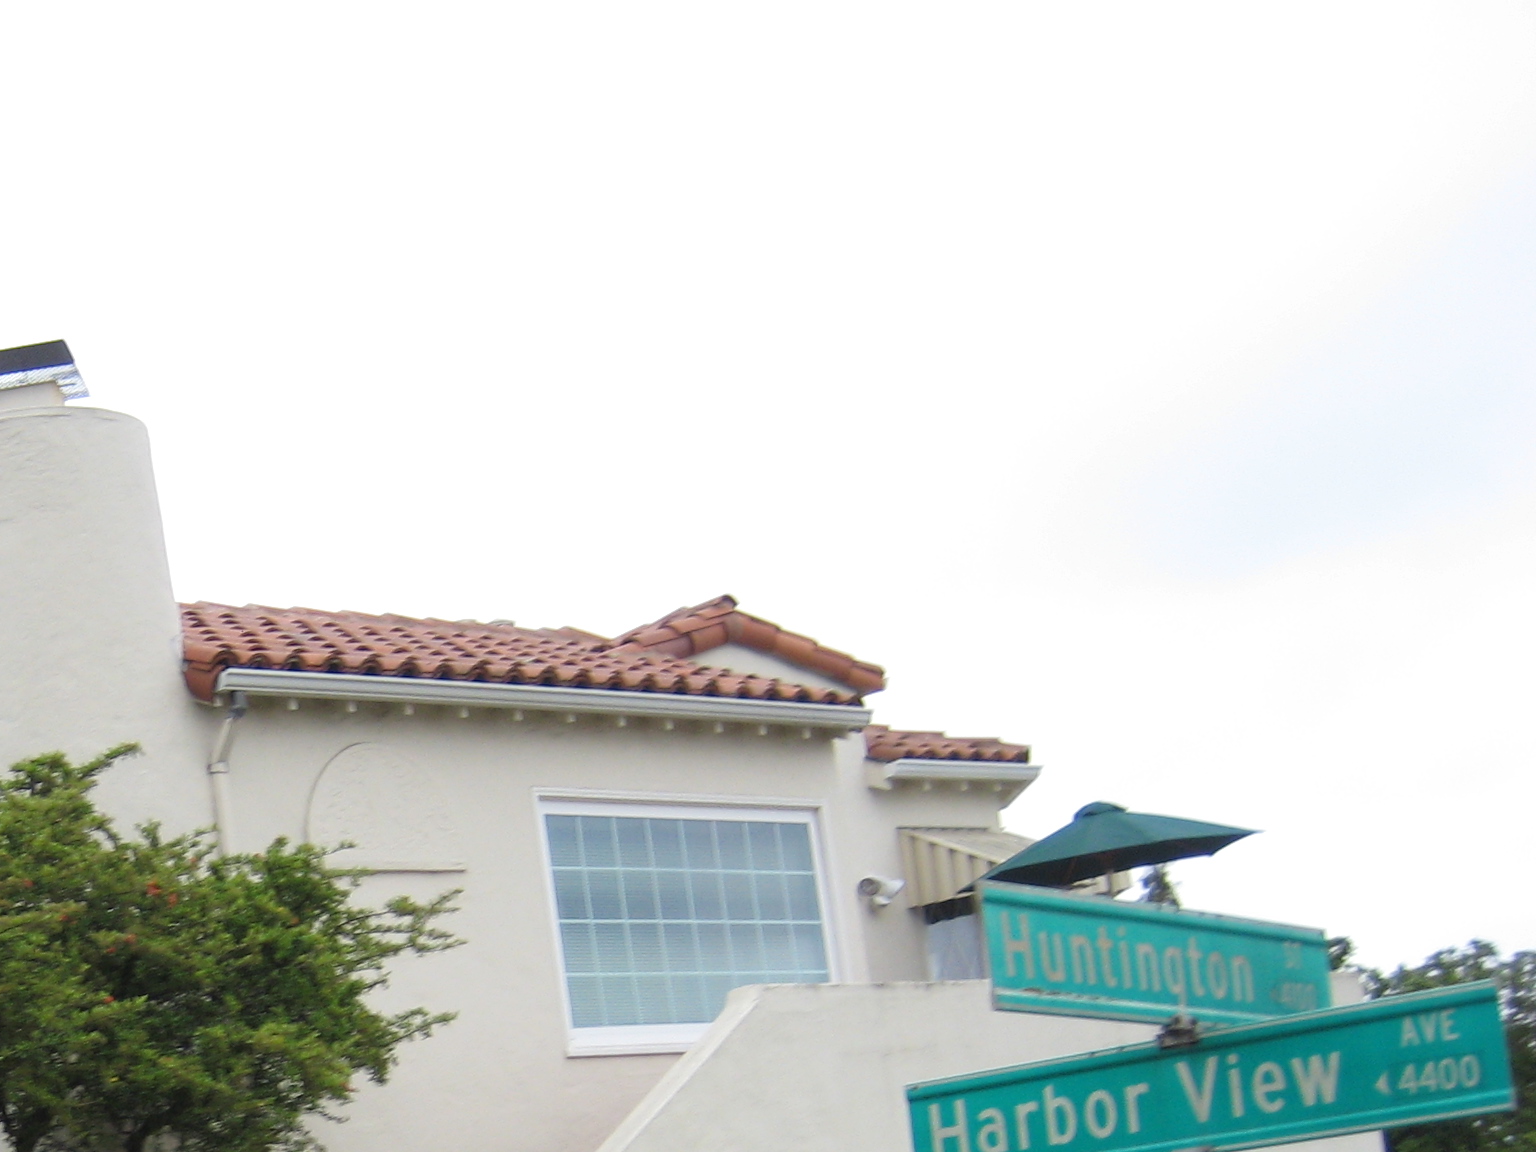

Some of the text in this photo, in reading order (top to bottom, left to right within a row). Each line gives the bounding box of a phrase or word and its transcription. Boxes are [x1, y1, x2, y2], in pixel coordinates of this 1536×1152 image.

[999, 911, 1254, 1006] Huntington
[1400, 1008, 1460, 1046] AVE
[1175, 1052, 1341, 1123] View
[1398, 1055, 1480, 1094] 4400
